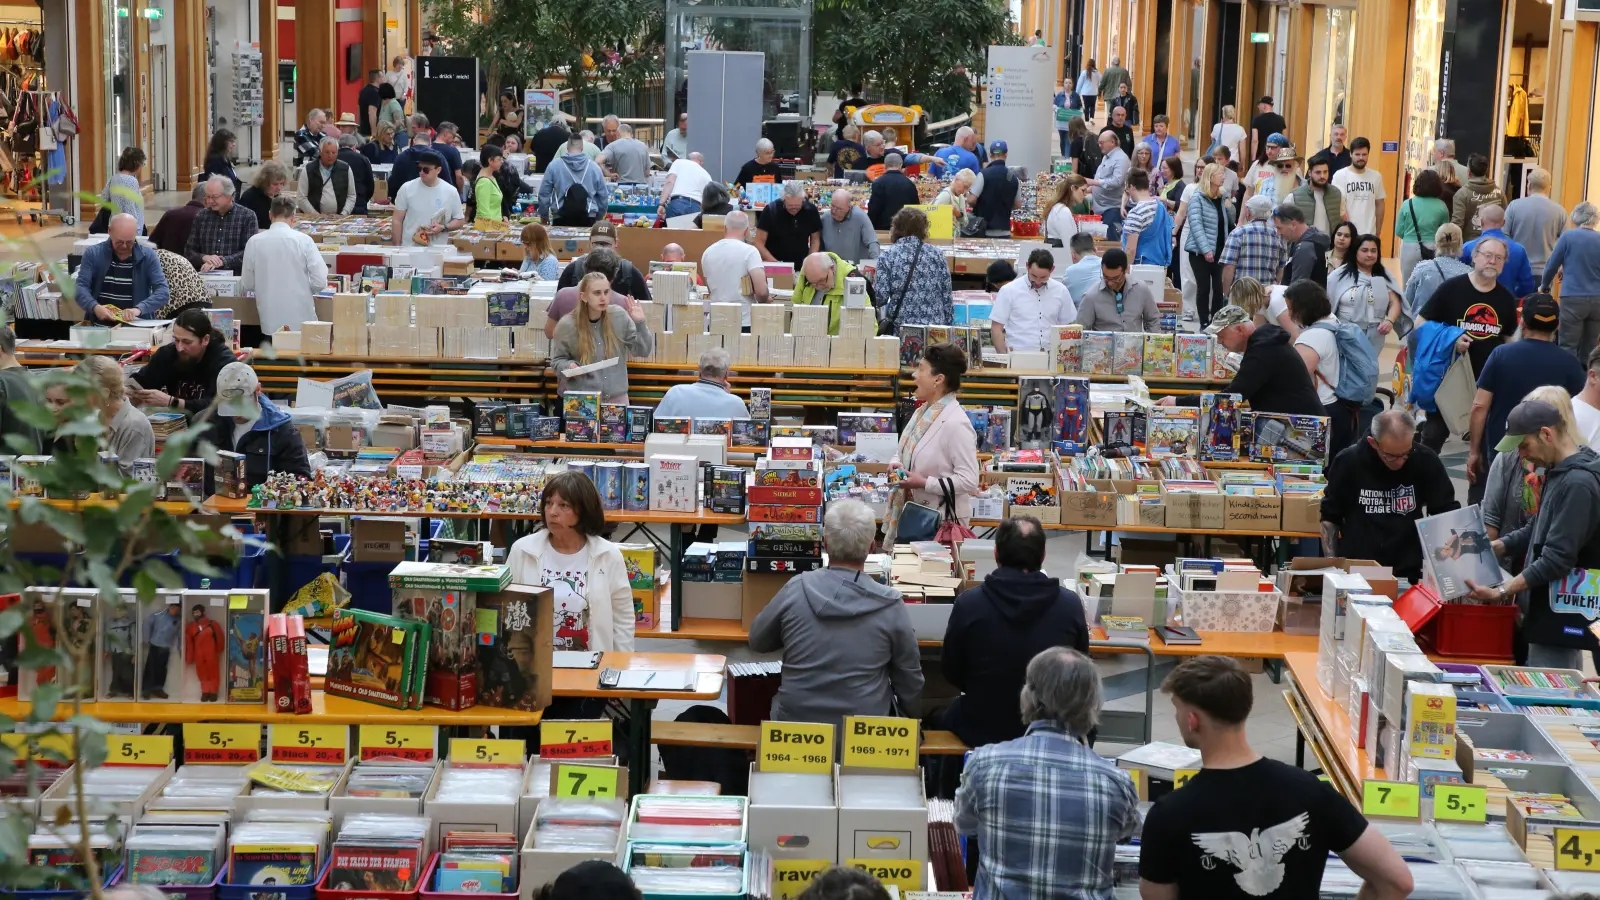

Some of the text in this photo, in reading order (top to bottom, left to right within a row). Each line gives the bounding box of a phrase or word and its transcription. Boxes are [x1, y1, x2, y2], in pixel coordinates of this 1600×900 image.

[1460, 321, 1486, 332] JURASSIC
[1358, 496, 1391, 505] FOOTBAL
[1394, 496, 1413, 511] NFL
[765, 523, 806, 536] DOMINION
[1555, 593, 1600, 610] POWER!
[770, 729, 825, 745] Bravo
[854, 721, 909, 738] Bravo
[209, 731, 234, 748] 5,-
[298, 730, 323, 748] 5,-
[385, 730, 409, 748] 5,-
[121, 742, 146, 760] 5,-
[194, 751, 222, 760] Stück
[247, 752, 255, 760] €
[281, 750, 309, 759] Stück
[335, 751, 343, 760] €
[424, 751, 431, 759] €
[475, 745, 499, 762] 5,-
[550, 746, 577, 755] Stück
[582, 745, 601, 754] 25,-
[602, 744, 609, 752] €
[850, 745, 876, 755] 1969
[885, 747, 910, 757] 1971
[765, 753, 791, 762] 1964
[801, 754, 827, 764] 1968
[1446, 794, 1475, 815] 5,-
[336, 856, 410, 869] DIE FALLE DER SPANIER
[772, 867, 820, 882] ravo
[855, 863, 912, 879] Bravo
